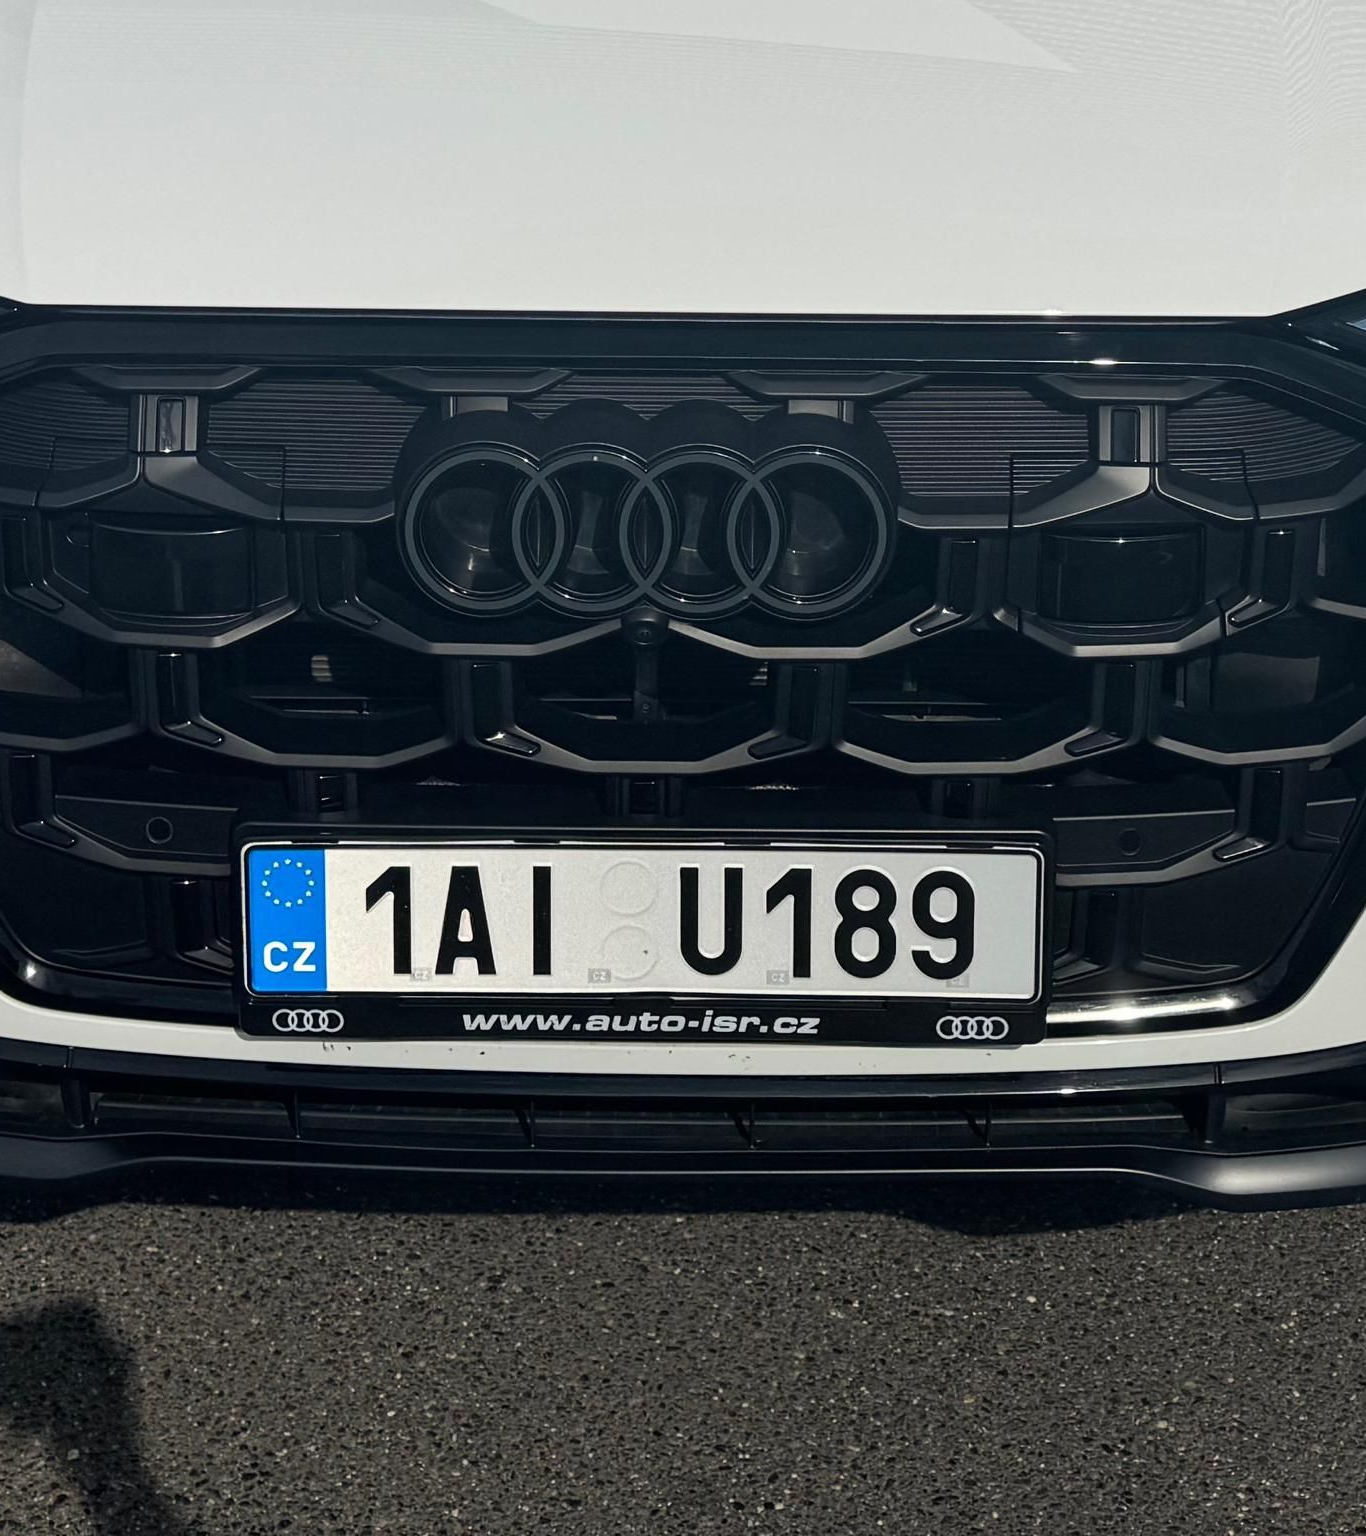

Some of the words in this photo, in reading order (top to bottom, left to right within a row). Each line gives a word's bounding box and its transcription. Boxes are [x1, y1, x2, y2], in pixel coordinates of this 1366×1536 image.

[365, 865, 552, 975] 1AI
[679, 866, 975, 980] U189
[263, 941, 316, 972] CZ
[415, 970, 427, 980] CZ
[592, 971, 607, 981] CZ
[771, 973, 785, 982] CZ
[462, 1009, 821, 1036] www.auto-isr.cz
